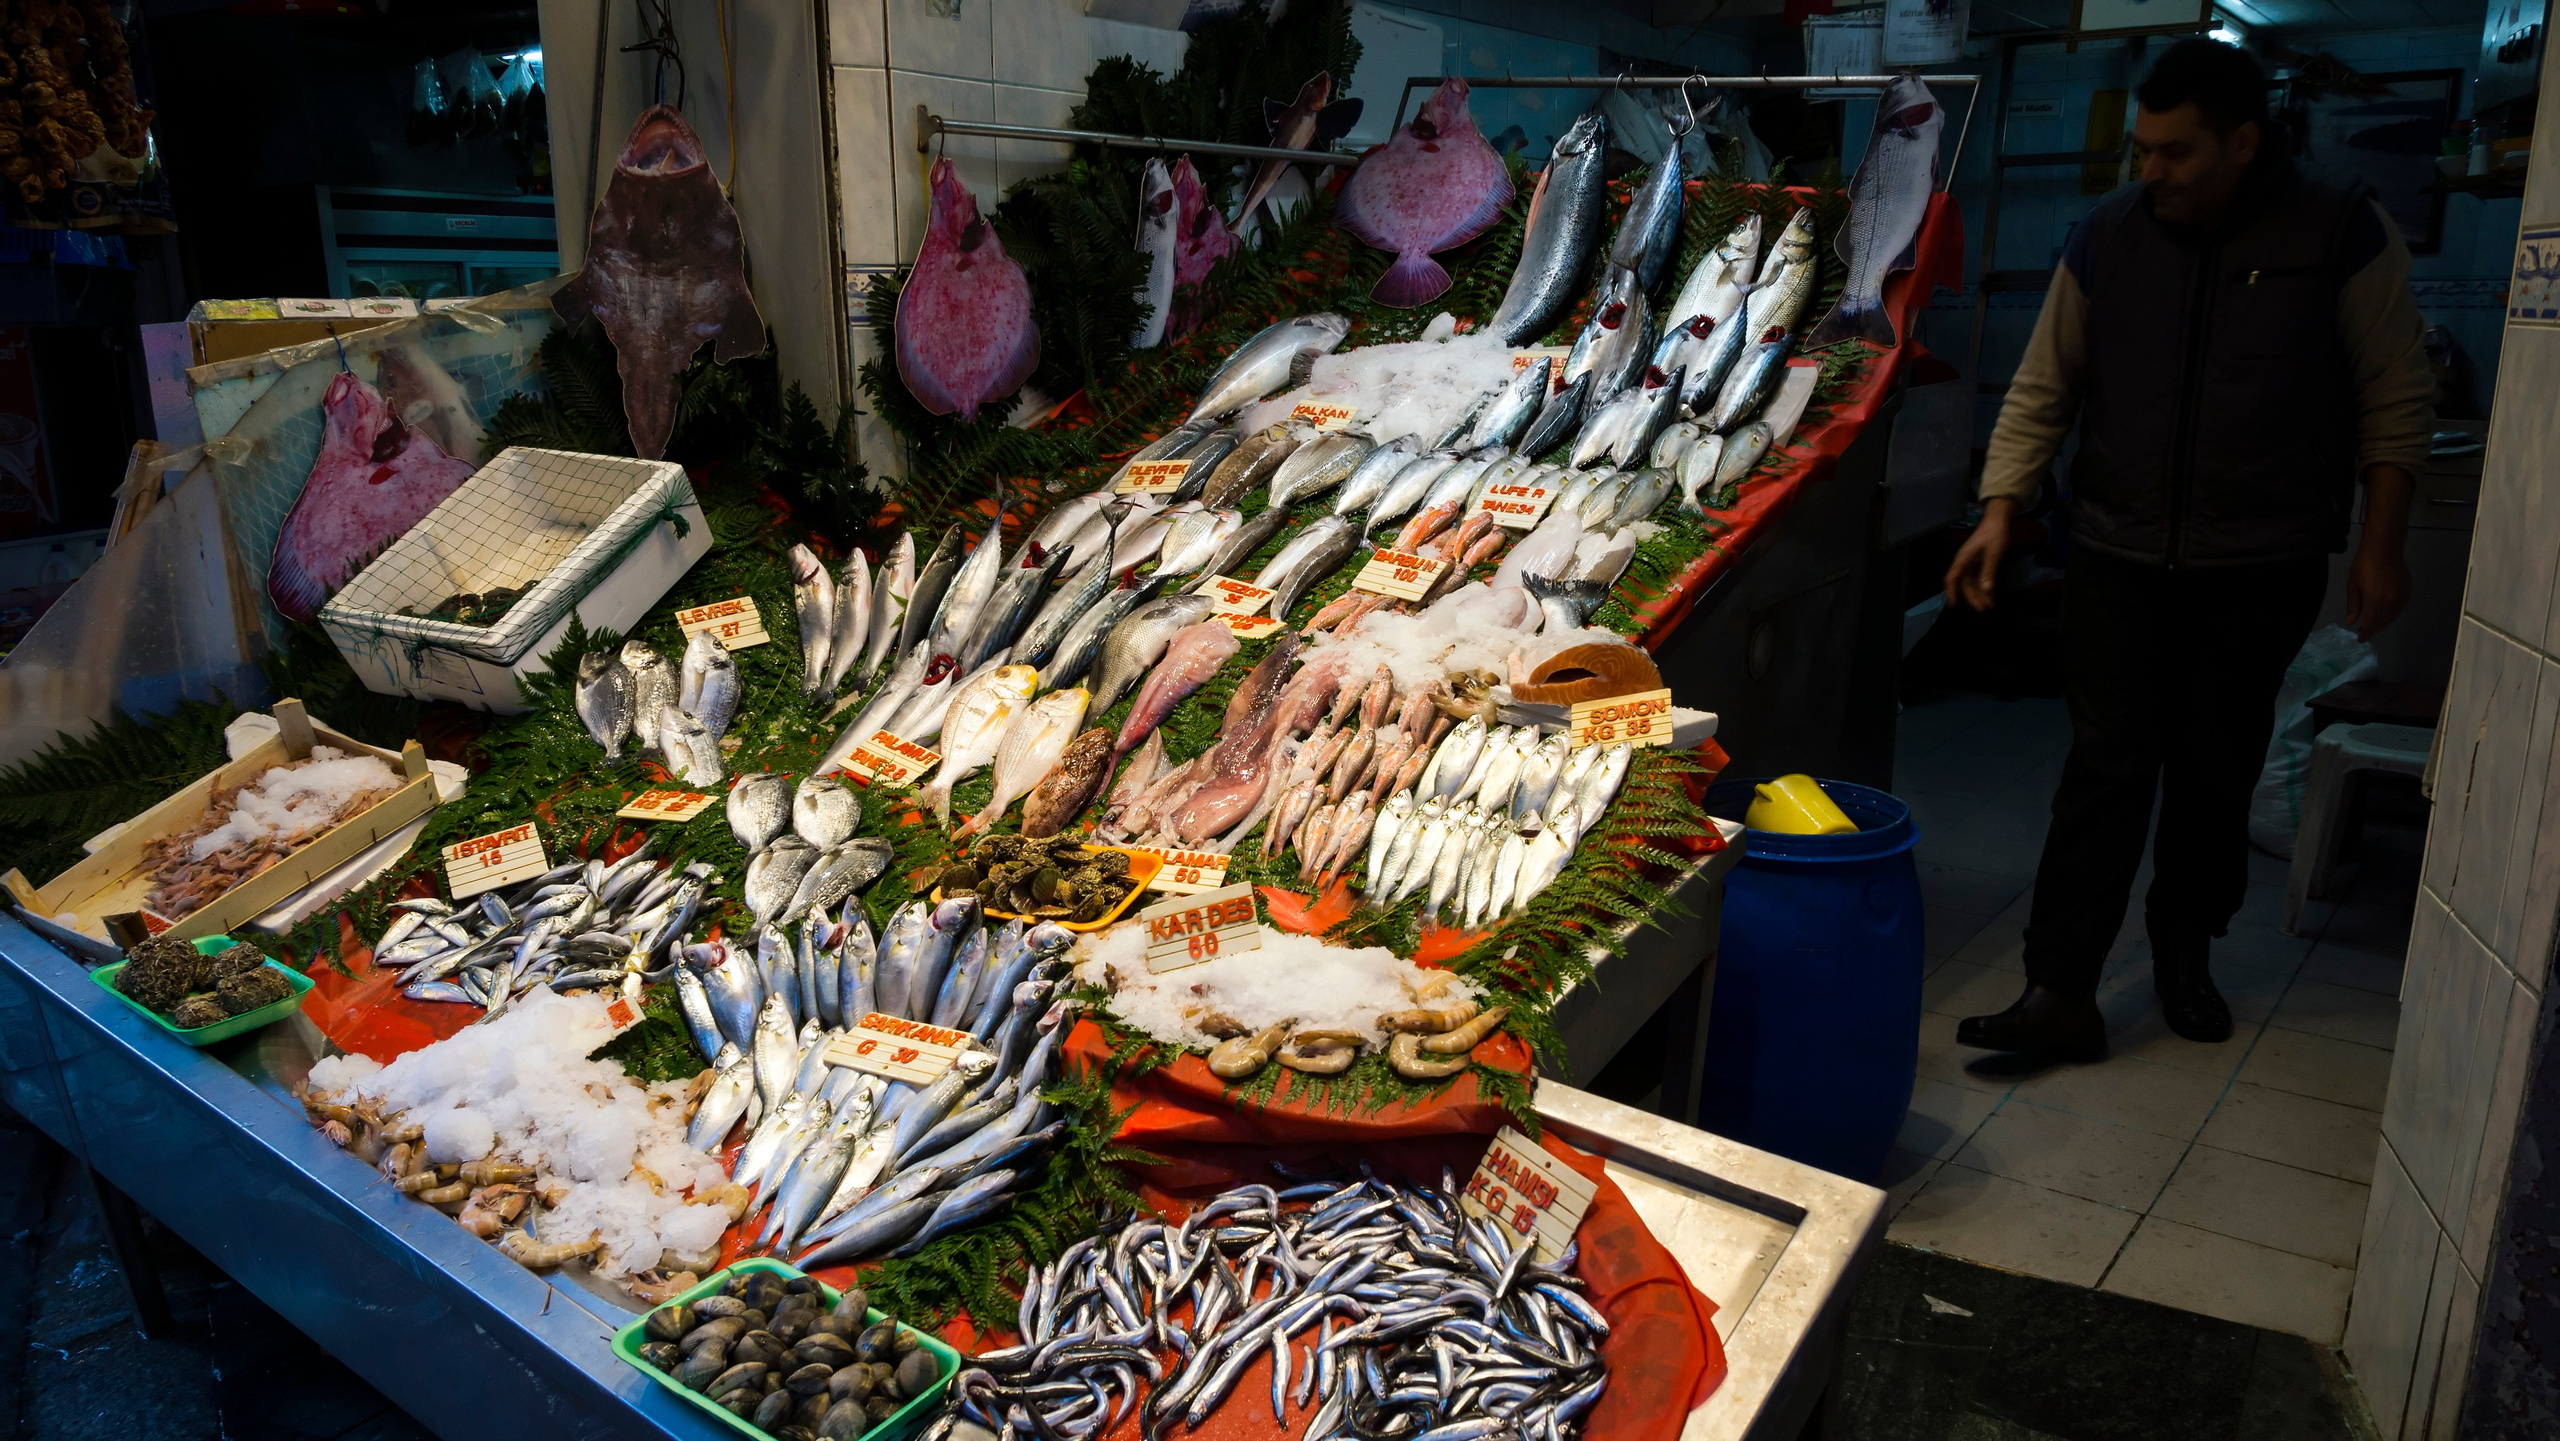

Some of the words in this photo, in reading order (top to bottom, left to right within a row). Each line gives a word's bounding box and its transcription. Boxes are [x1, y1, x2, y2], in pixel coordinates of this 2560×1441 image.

[1293, 404, 1349, 419] KALKAN
[1373, 549, 1438, 572] BARBUN
[1393, 568, 1419, 583] 100
[1216, 580, 1270, 599] MEZGIT
[681, 600, 746, 625] LEVREK
[721, 621, 740, 637] 27
[1590, 698, 1665, 724] SOMON
[1583, 724, 1615, 742] KG
[1626, 718, 1651, 736] 35
[871, 731, 940, 765] PALAMUT
[631, 799, 661, 809] KG
[479, 850, 502, 868] 15
[1174, 868, 1200, 884] 50
[1188, 932, 1219, 959] 60
[860, 1012, 966, 1047] SARIKANAT
[856, 1039, 877, 1055] G
[890, 1047, 919, 1064] 30
[1487, 1146, 1559, 1210] HAMSI
[1511, 1203, 1537, 1234] 15
